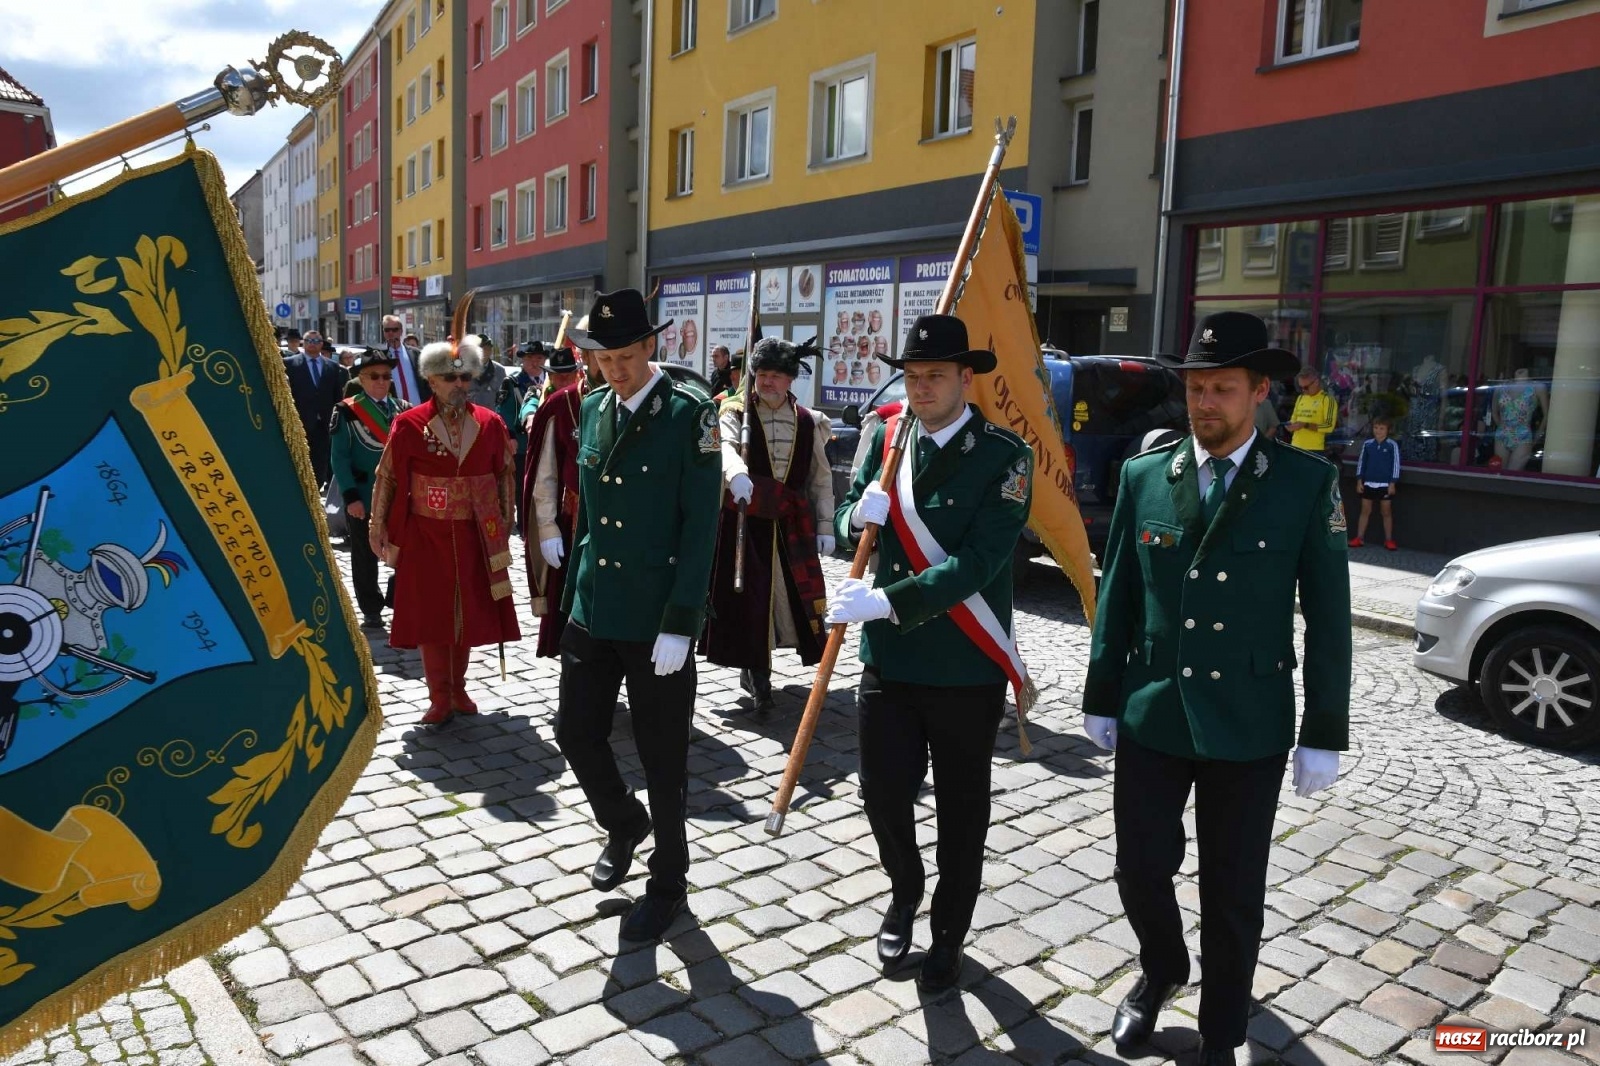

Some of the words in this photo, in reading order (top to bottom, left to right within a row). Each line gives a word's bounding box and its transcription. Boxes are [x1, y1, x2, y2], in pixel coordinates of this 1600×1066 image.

[829, 266, 891, 284] STOMATOLOGIA
[916, 260, 954, 278] PROTET
[663, 281, 700, 295] STOMATOLOGIA
[715, 277, 749, 292] PROTETYKA
[850, 288, 885, 298] METAMORFOZY
[913, 289, 925, 297] MASZ
[349, 300, 358, 312] P
[1113, 314, 1125, 325] 52
[825, 390, 838, 402] TEL.
[839, 391, 848, 402] 32
[849, 392, 859, 403] 43
[95, 460, 128, 507] 1864
[199, 451, 272, 579] BRACTWO
[161, 429, 271, 618] STRZELECKIE
[182, 610, 218, 653] 1924
